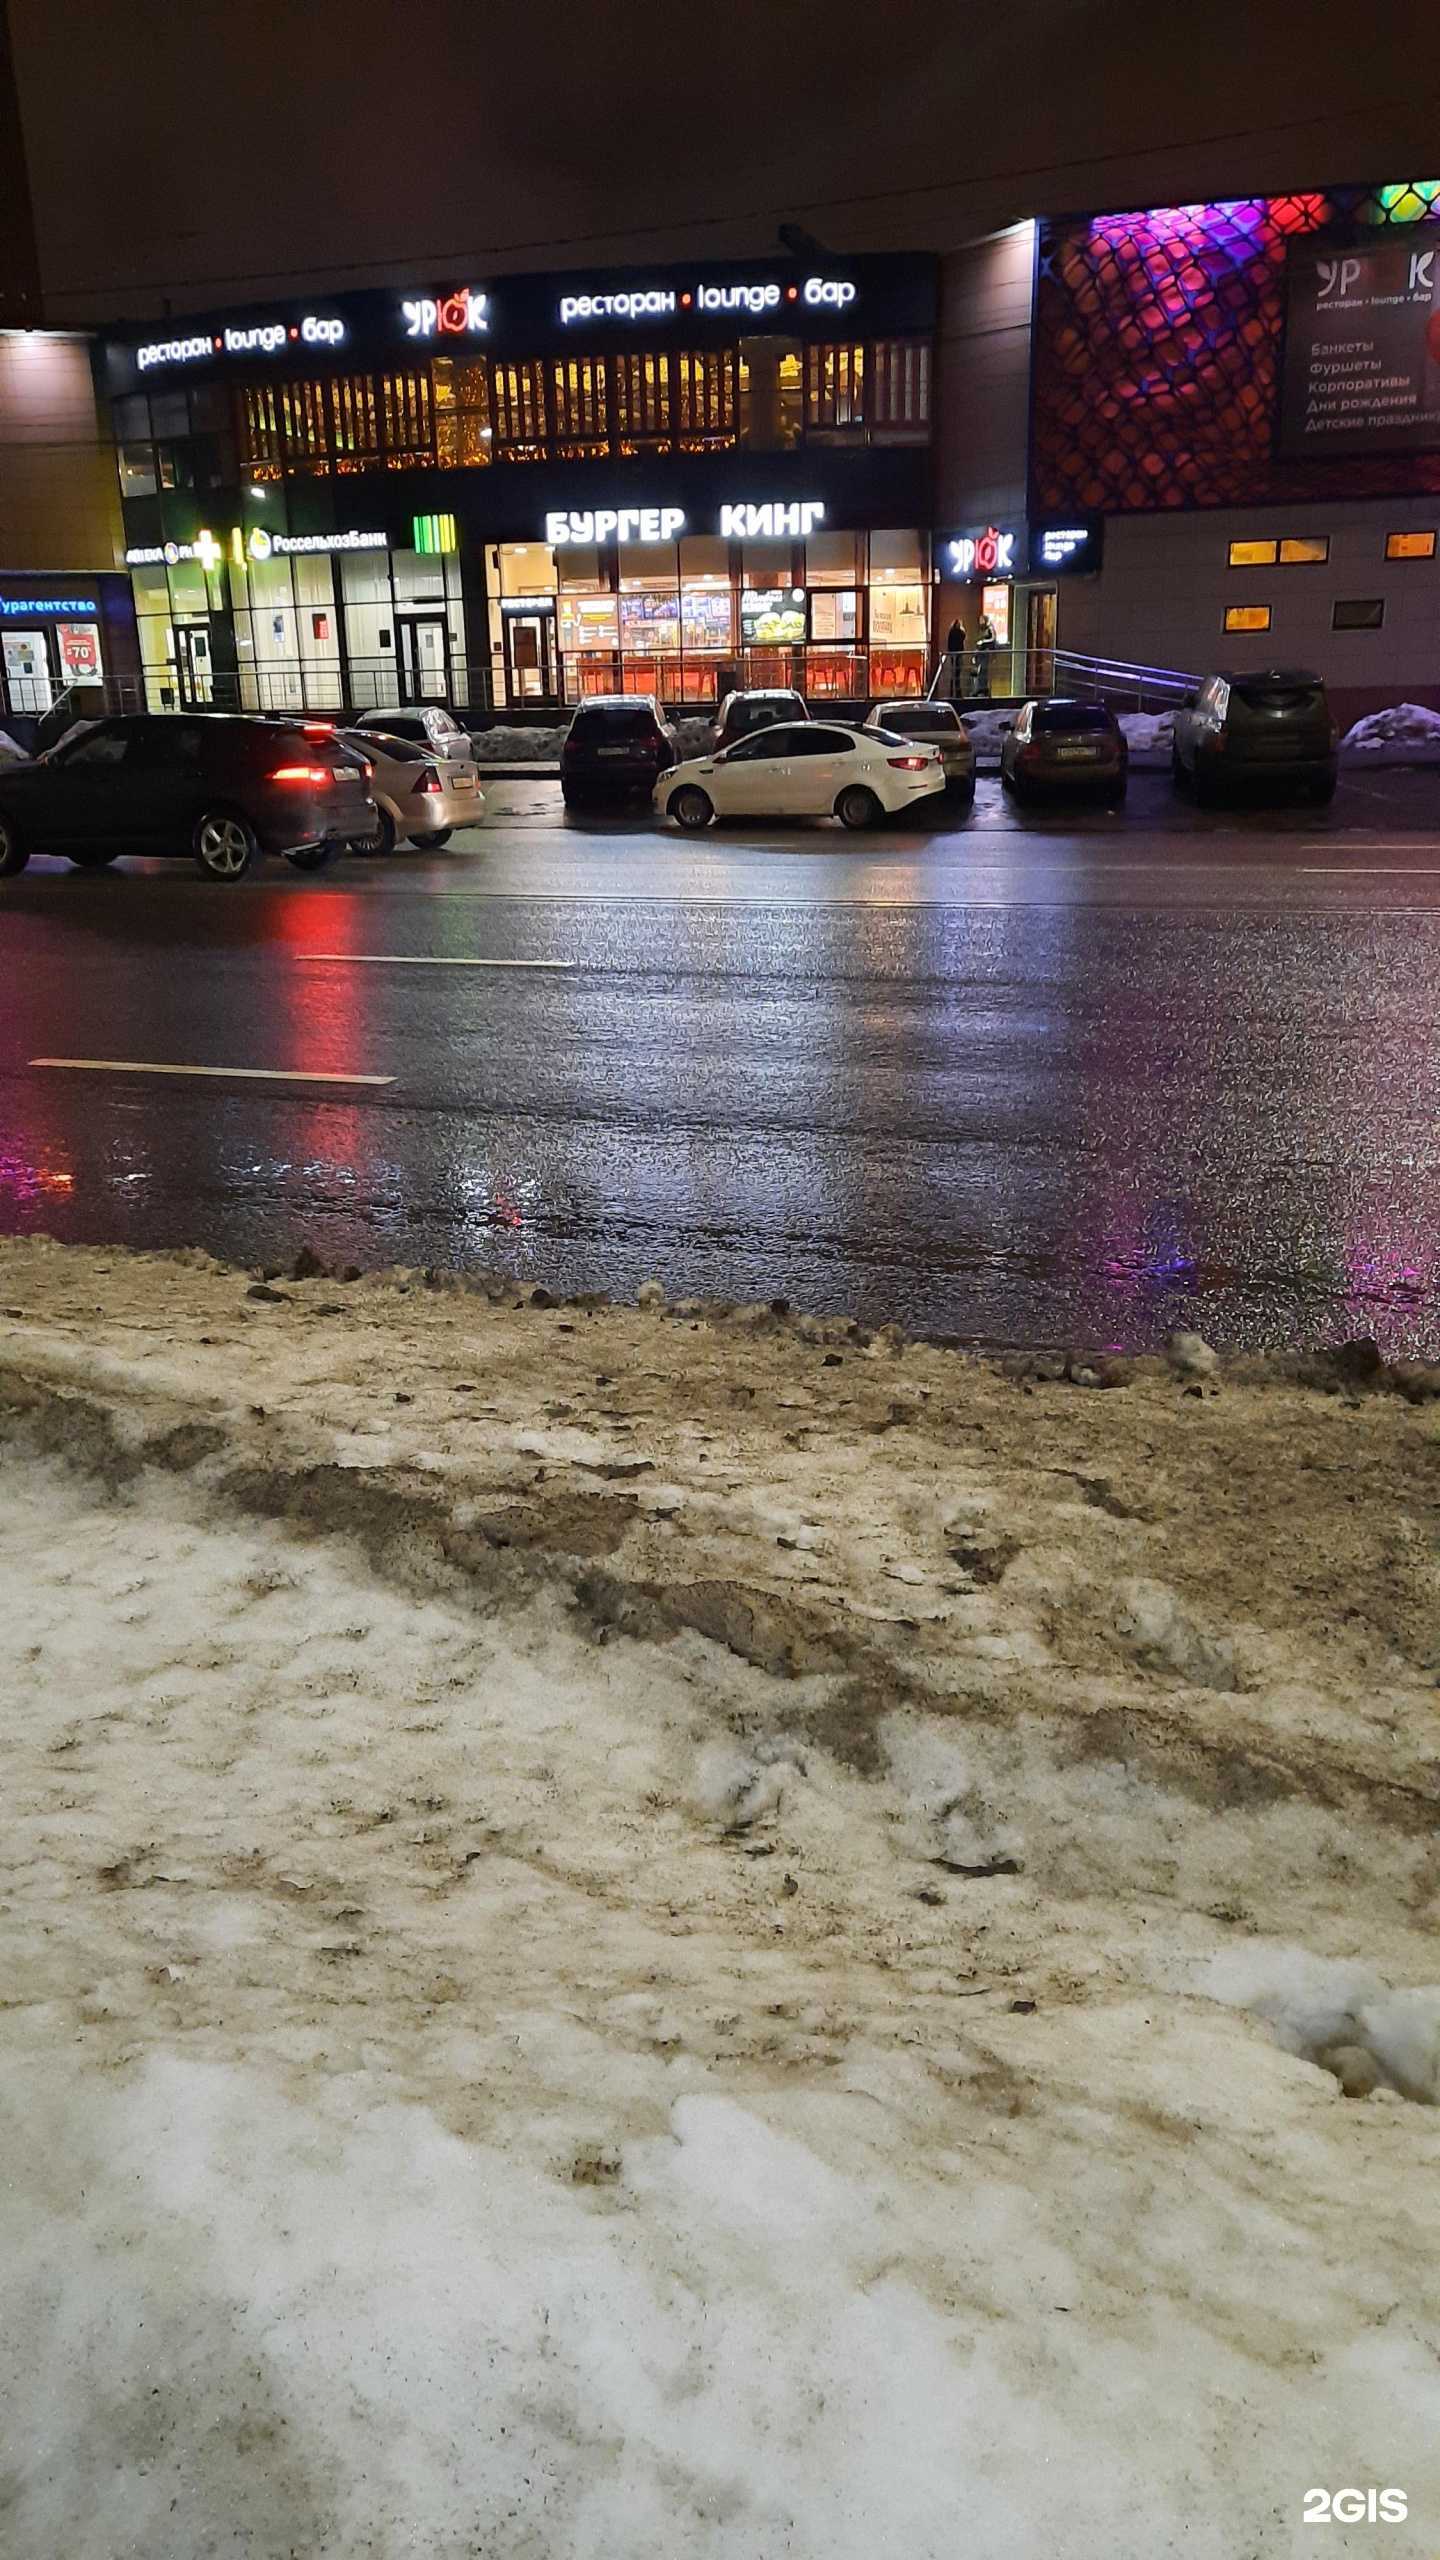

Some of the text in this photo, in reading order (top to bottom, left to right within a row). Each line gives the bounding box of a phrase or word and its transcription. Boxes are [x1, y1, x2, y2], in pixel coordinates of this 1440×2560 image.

[560, 278, 855, 323] ресторан lounge бар
[1316, 292, 1432, 311] ресторан lounge бар
[137, 317, 344, 370] ресторан lounge бар
[1311, 341, 1374, 356] Банкеты
[1310, 360, 1382, 375] Фуршеты
[1308, 376, 1410, 393] Корпоративы
[1306, 394, 1417, 414] Дни рождения
[1305, 416, 1364, 432] Детские
[545, 502, 824, 543] БУРГЕР КИНГ
[272, 530, 388, 551] РоссельхозБанк
